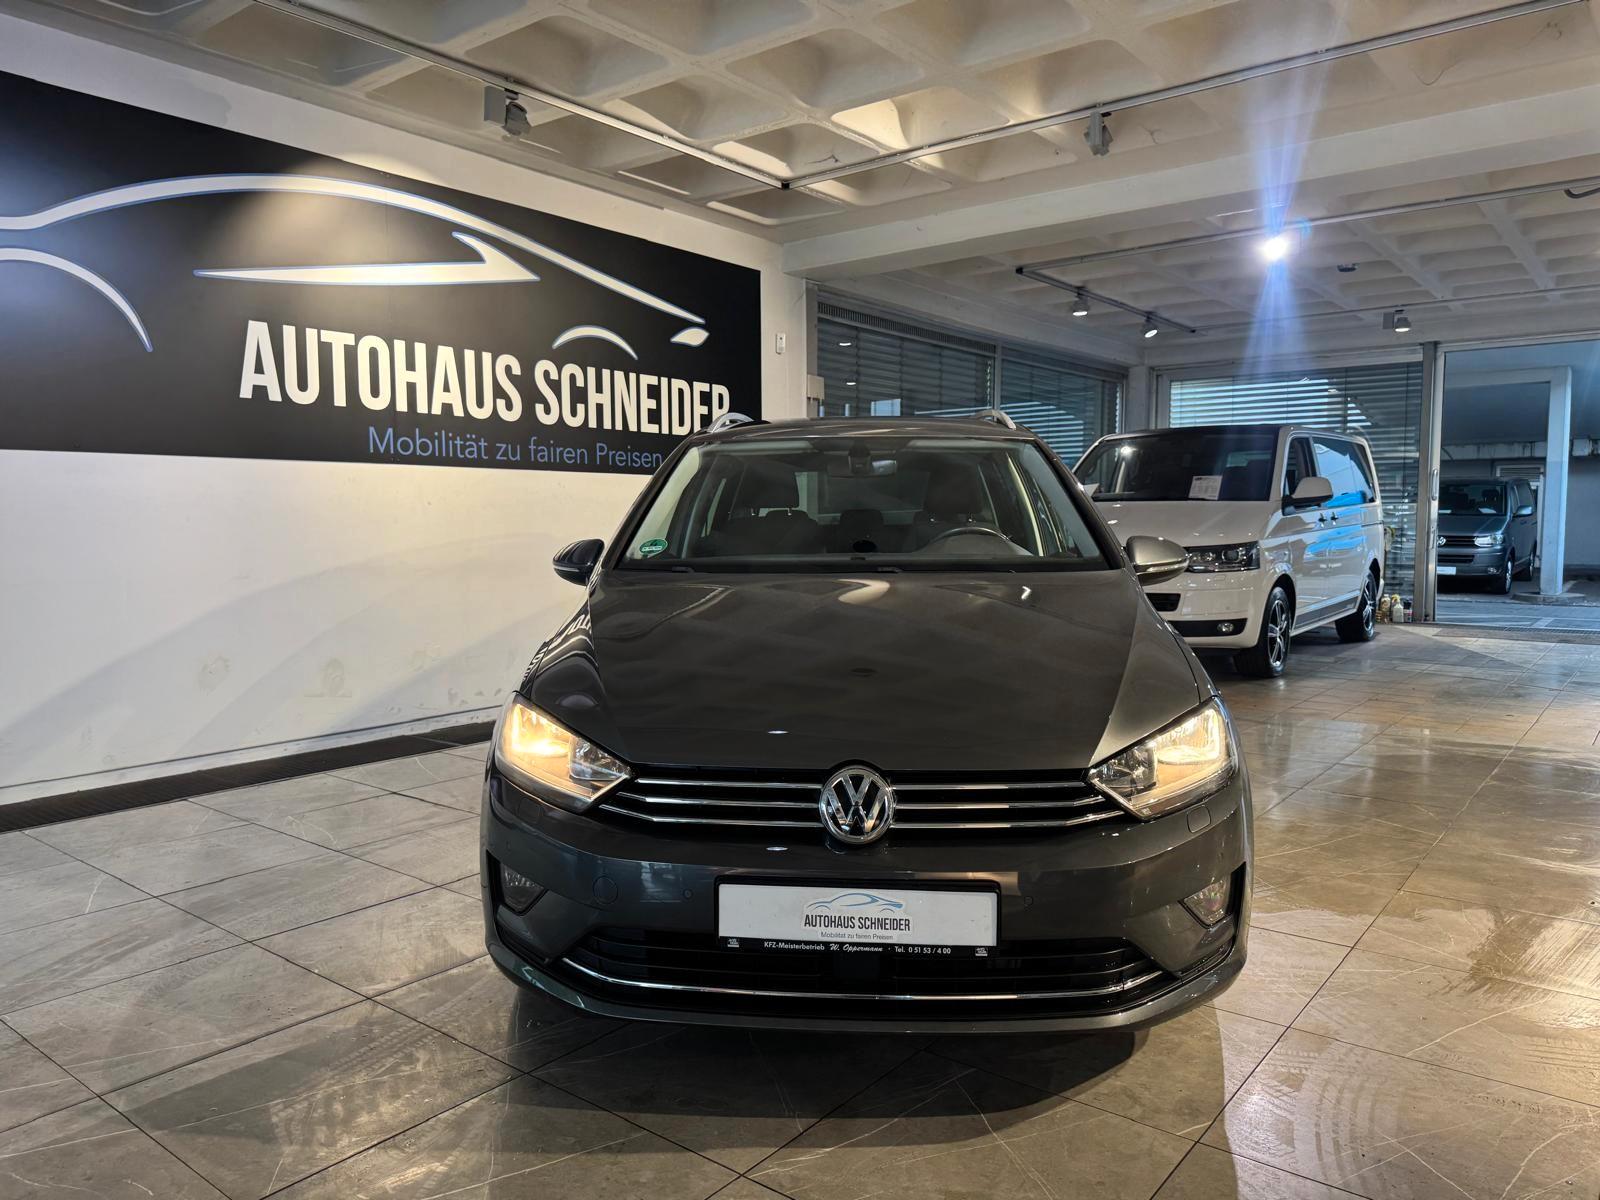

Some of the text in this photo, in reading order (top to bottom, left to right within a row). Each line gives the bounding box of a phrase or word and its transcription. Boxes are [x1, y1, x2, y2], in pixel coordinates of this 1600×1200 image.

[239, 320, 730, 436] AUTOHAUS SCHNEIDER
[368, 426, 663, 468] Mobilität zu fairen Preisen
[822, 768, 892, 842] VW
[804, 914, 911, 931] AUTOHAUS SCHNEIDER
[764, 941, 825, 950] KFZ-Meisterbetrieb
[843, 943, 883, 953] Oppermann
[895, 945, 906, 953] Tel.
